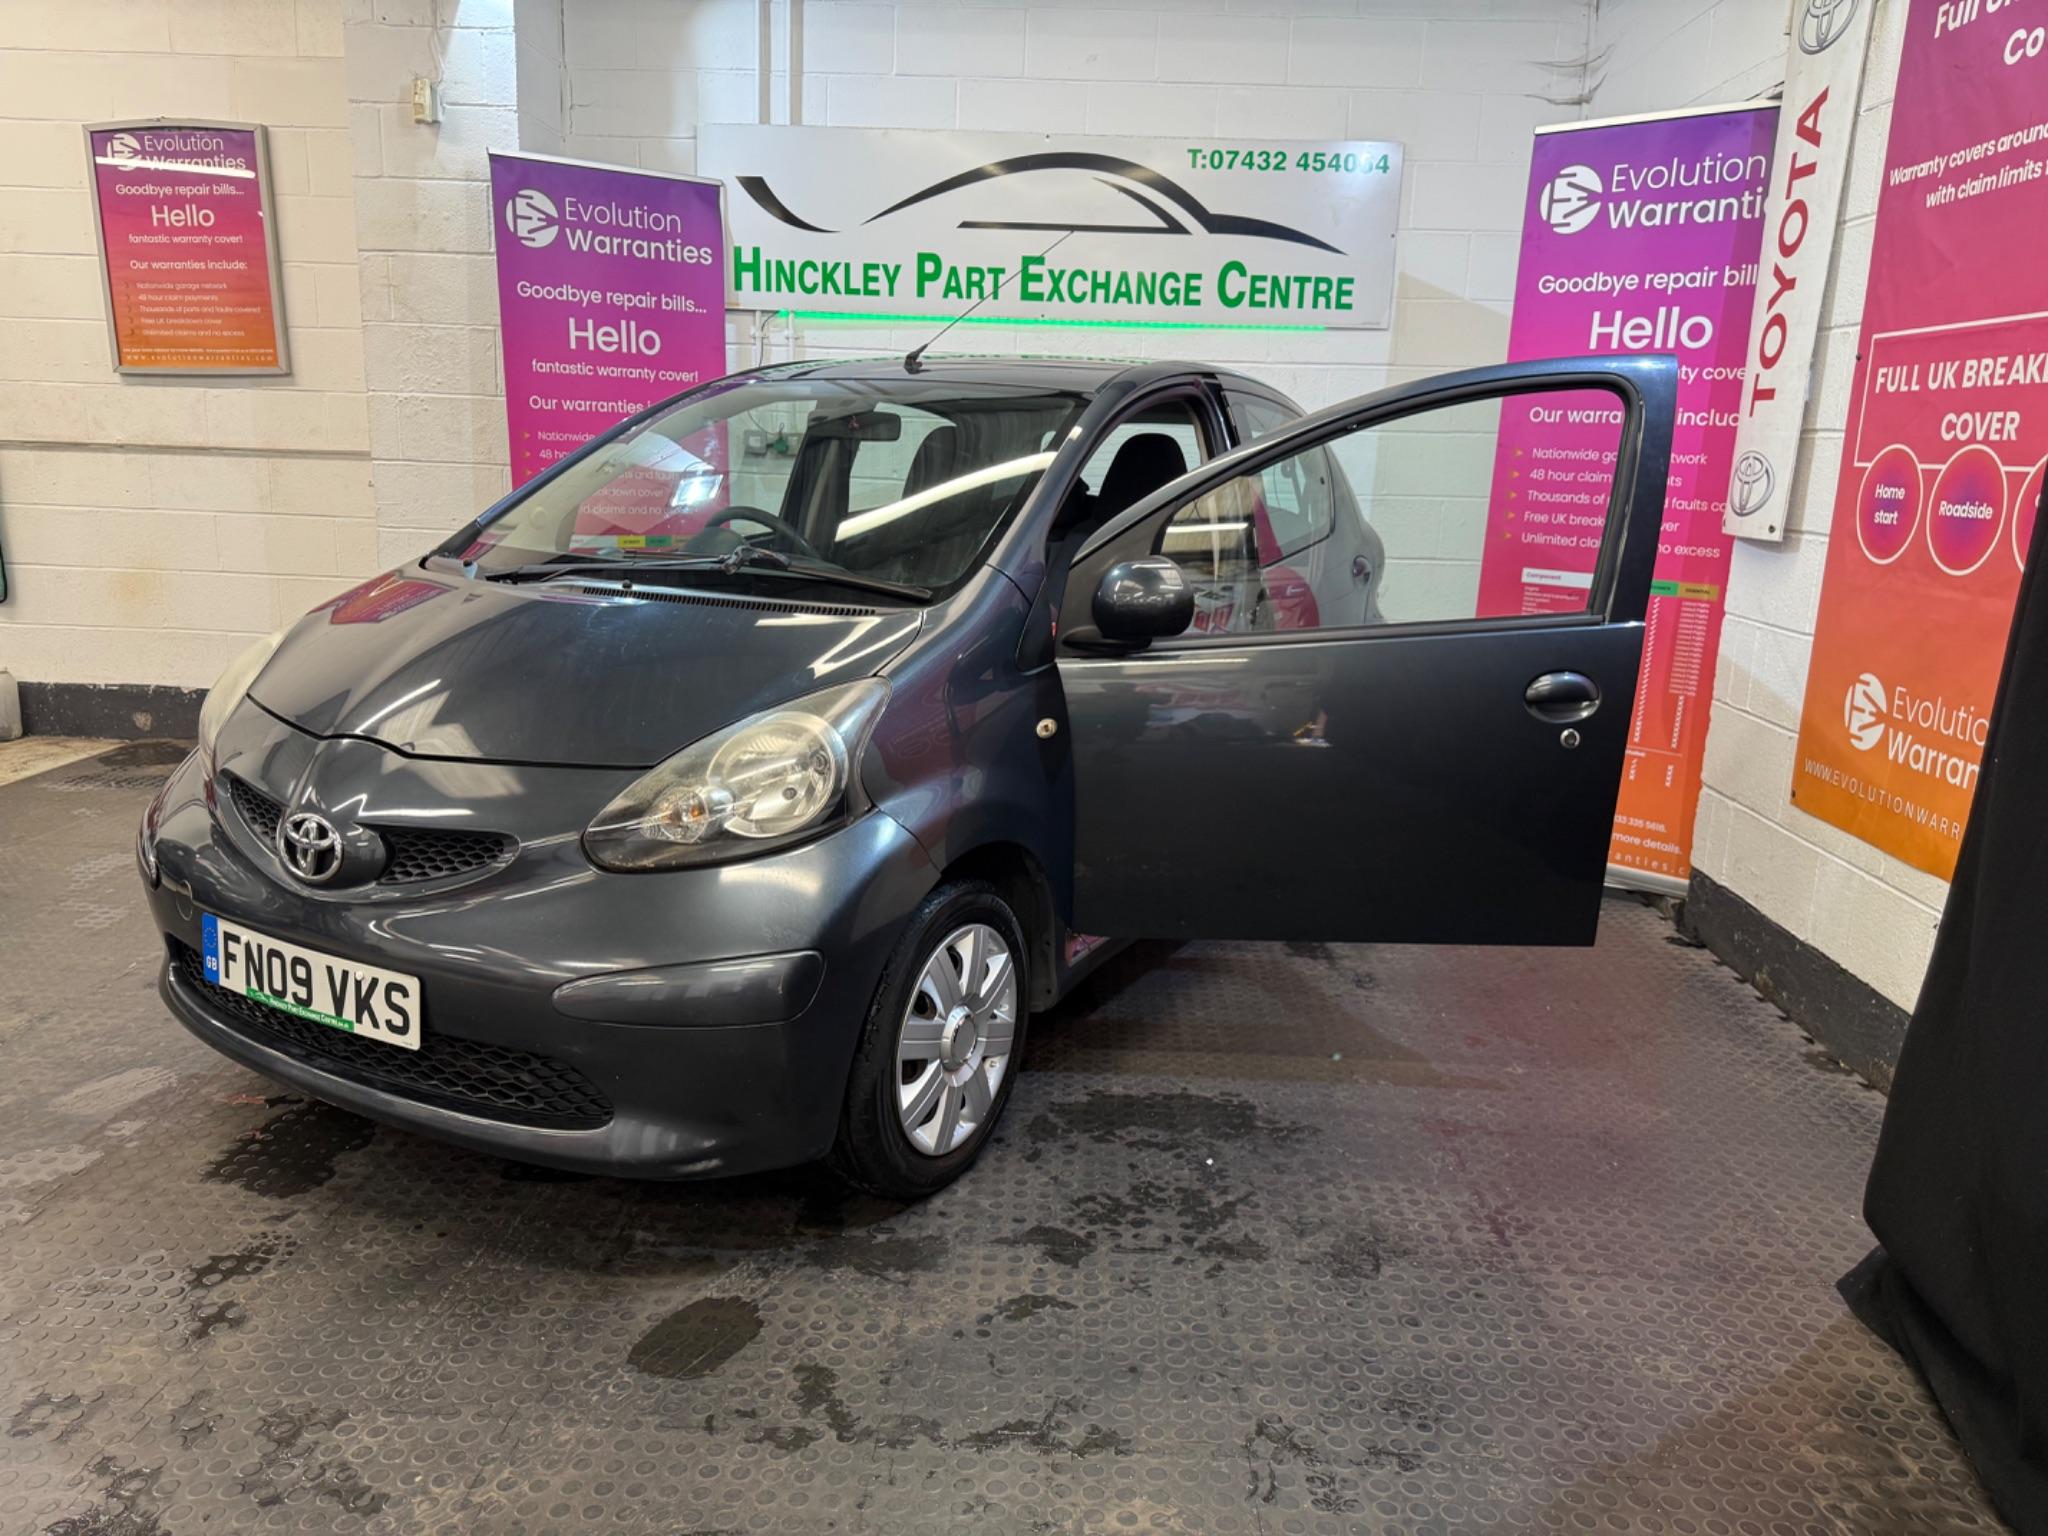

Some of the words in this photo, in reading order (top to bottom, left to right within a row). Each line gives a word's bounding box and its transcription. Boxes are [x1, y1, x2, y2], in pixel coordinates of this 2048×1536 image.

[144, 134, 224, 151] Evolution
[1187, 148, 1288, 171] T:07432
[1890, 155, 1948, 187] Warranty
[1949, 139, 1996, 168] covers
[1611, 153, 1767, 193] Evolution
[1926, 183, 1956, 209] with
[1957, 174, 1997, 201] claim
[1997, 159, 2043, 189] limits
[116, 184, 173, 198] Goodbye
[175, 184, 210, 198] repair
[213, 184, 244, 195] bills...
[152, 204, 215, 227] Hello
[564, 197, 682, 234] Evolution
[1607, 186, 1766, 230] Warranti
[129, 234, 170, 243] fantastic
[172, 235, 212, 245] warranty
[565, 227, 713, 265] Warranties
[1749, 86, 1830, 417] TOYOTA
[130, 260, 149, 270] Our
[151, 260, 206, 270] warranties
[208, 260, 248, 270] include:
[733, 246, 902, 297] HINCKLEY
[916, 252, 1006, 301] PART
[1019, 255, 1203, 307] EXCHANGE
[1217, 260, 1355, 311] CENTRE
[1538, 272, 1639, 297] Goodbye
[1644, 266, 1718, 295] repair
[517, 281, 602, 307] Goodbye
[606, 290, 658, 311] repair
[661, 294, 707, 314] bills...
[568, 317, 661, 356] Hello
[1588, 306, 1714, 350] Hello
[532, 359, 593, 376] fantastic
[597, 365, 656, 383] warranty
[658, 369, 699, 382] cover!
[1875, 364, 1920, 394] FULL
[1928, 360, 1961, 390] UK
[1962, 352, 2048, 389] BREAK
[529, 395, 558, 411] Our
[562, 399, 644, 414] warranties
[1529, 407, 1563, 424] Our
[1940, 411, 2021, 441] COVER
[539, 449, 553, 459] 48
[1532, 448, 1599, 463] Nationwide
[1529, 469, 1544, 480] 48
[1547, 469, 1576, 482] hour
[1527, 489, 1590, 504] Thousands
[1592, 492, 1605, 505] of
[1672, 497, 1708, 511] faults
[1875, 483, 1906, 500] Home
[1524, 511, 1549, 522] Free
[1551, 512, 1567, 523] UK
[1874, 510, 1899, 525] start
[1938, 500, 1993, 520] Roadside
[1521, 531, 1577, 547] Unlimited
[1674, 545, 1720, 558] excess
[223, 930, 314, 1009] FN09
[326, 964, 411, 1037] VKS
